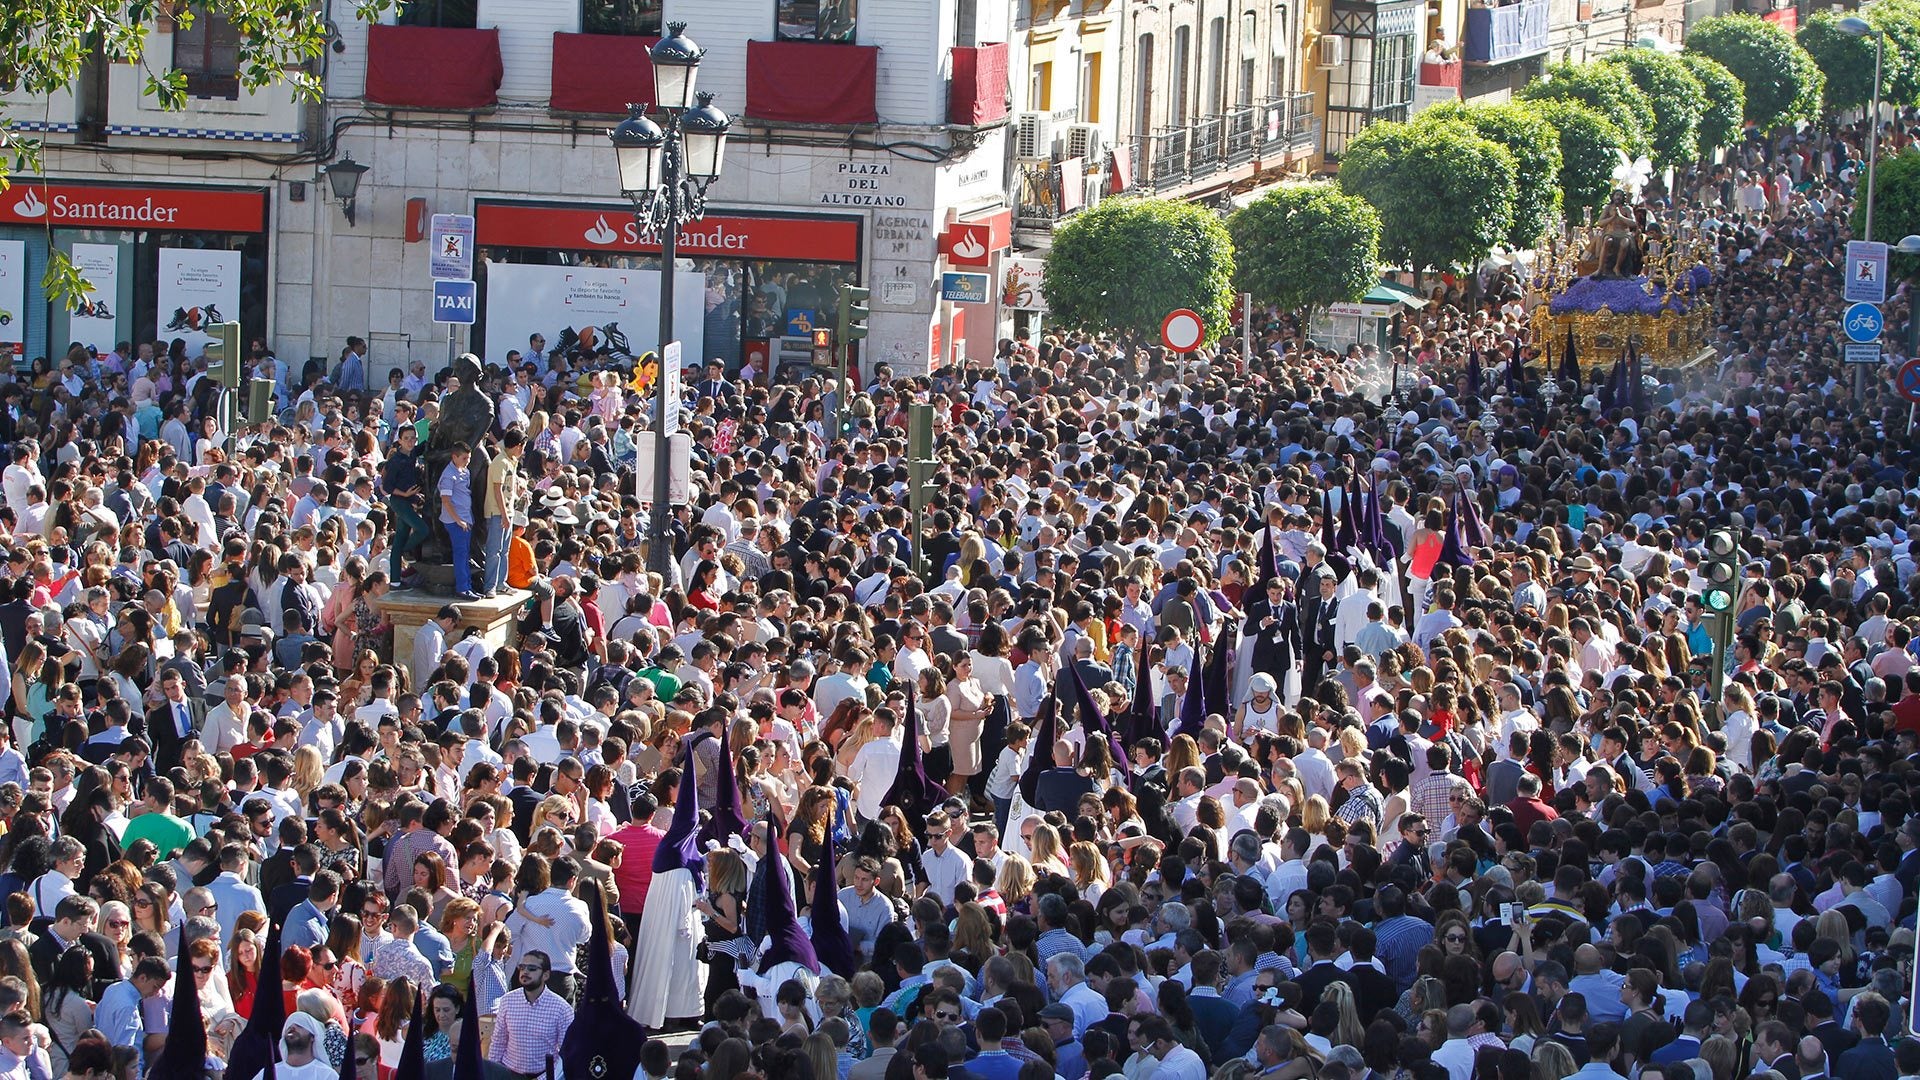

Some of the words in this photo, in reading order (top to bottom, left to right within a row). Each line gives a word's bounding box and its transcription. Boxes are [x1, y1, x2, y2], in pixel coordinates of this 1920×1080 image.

[838, 163, 889, 175] PLAZA
[848, 178, 878, 190] DEL
[821, 193, 905, 207] ALTOZANO
[53, 194, 178, 223] Santander
[876, 216, 929, 229] AGENCIA
[876, 228, 923, 241] URBANA
[895, 266, 907, 277] 14
[437, 295, 472, 309] TAXI
[945, 290, 982, 301] TELEBANCO
